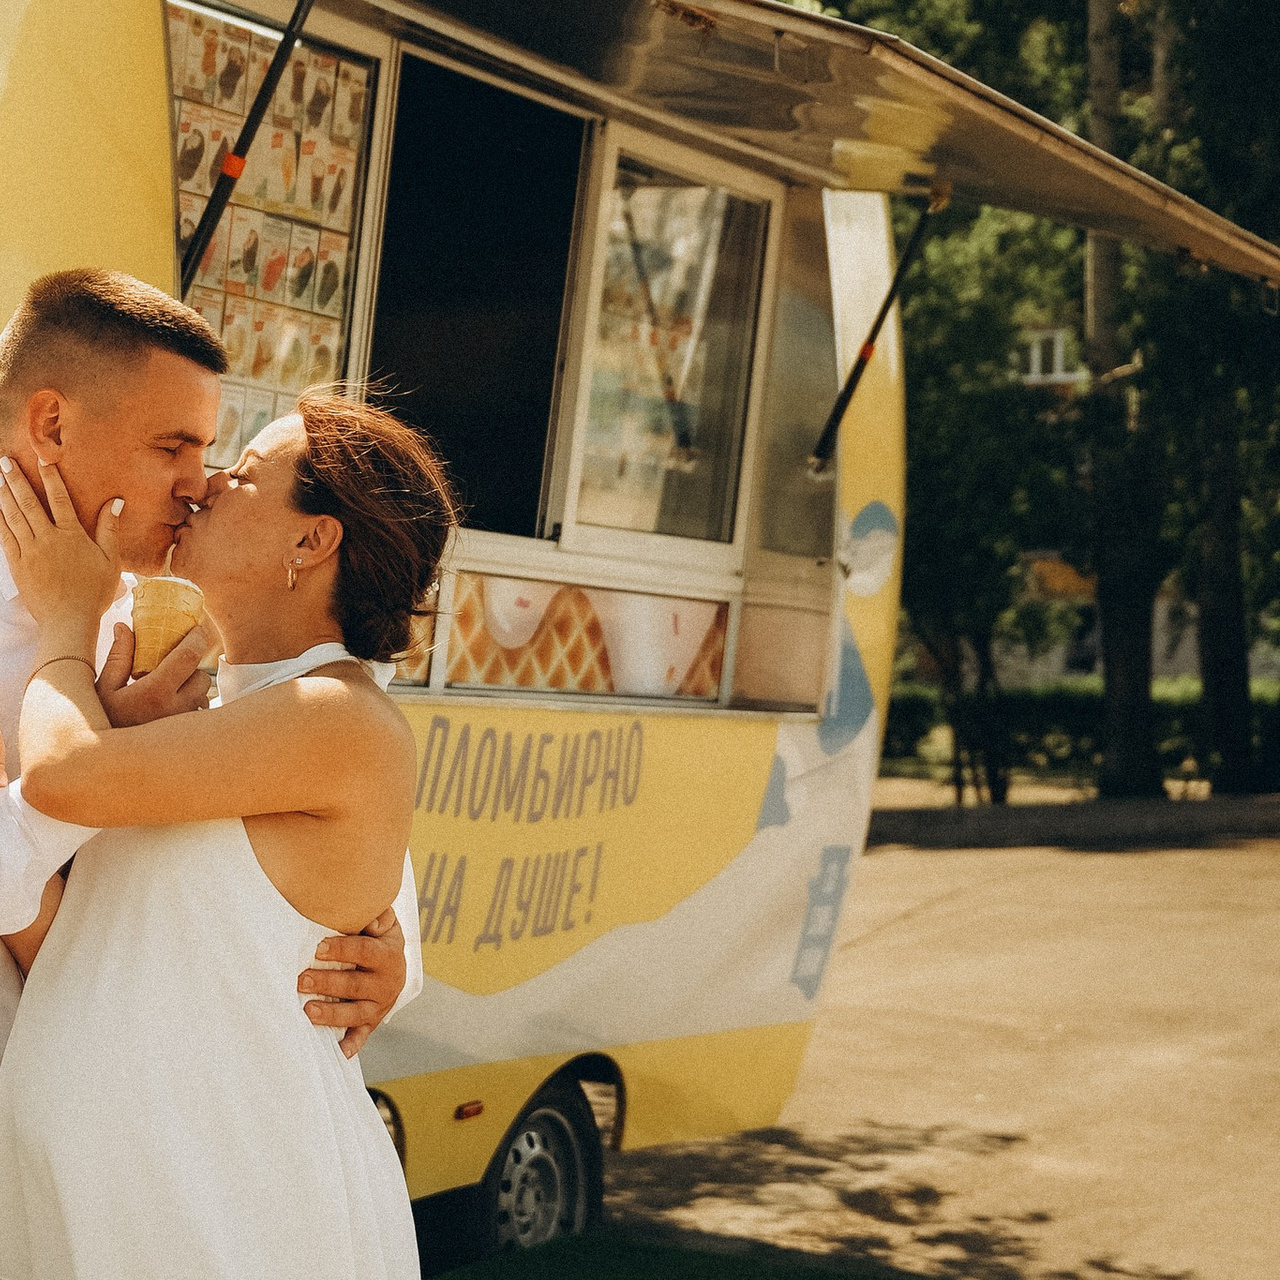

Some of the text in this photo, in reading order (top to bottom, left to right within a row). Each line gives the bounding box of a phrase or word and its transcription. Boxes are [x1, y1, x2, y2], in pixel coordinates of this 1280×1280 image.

[414, 715, 644, 823] ПЛОМБИРНО
[419, 841, 603, 953] НА ДУШЕ!
